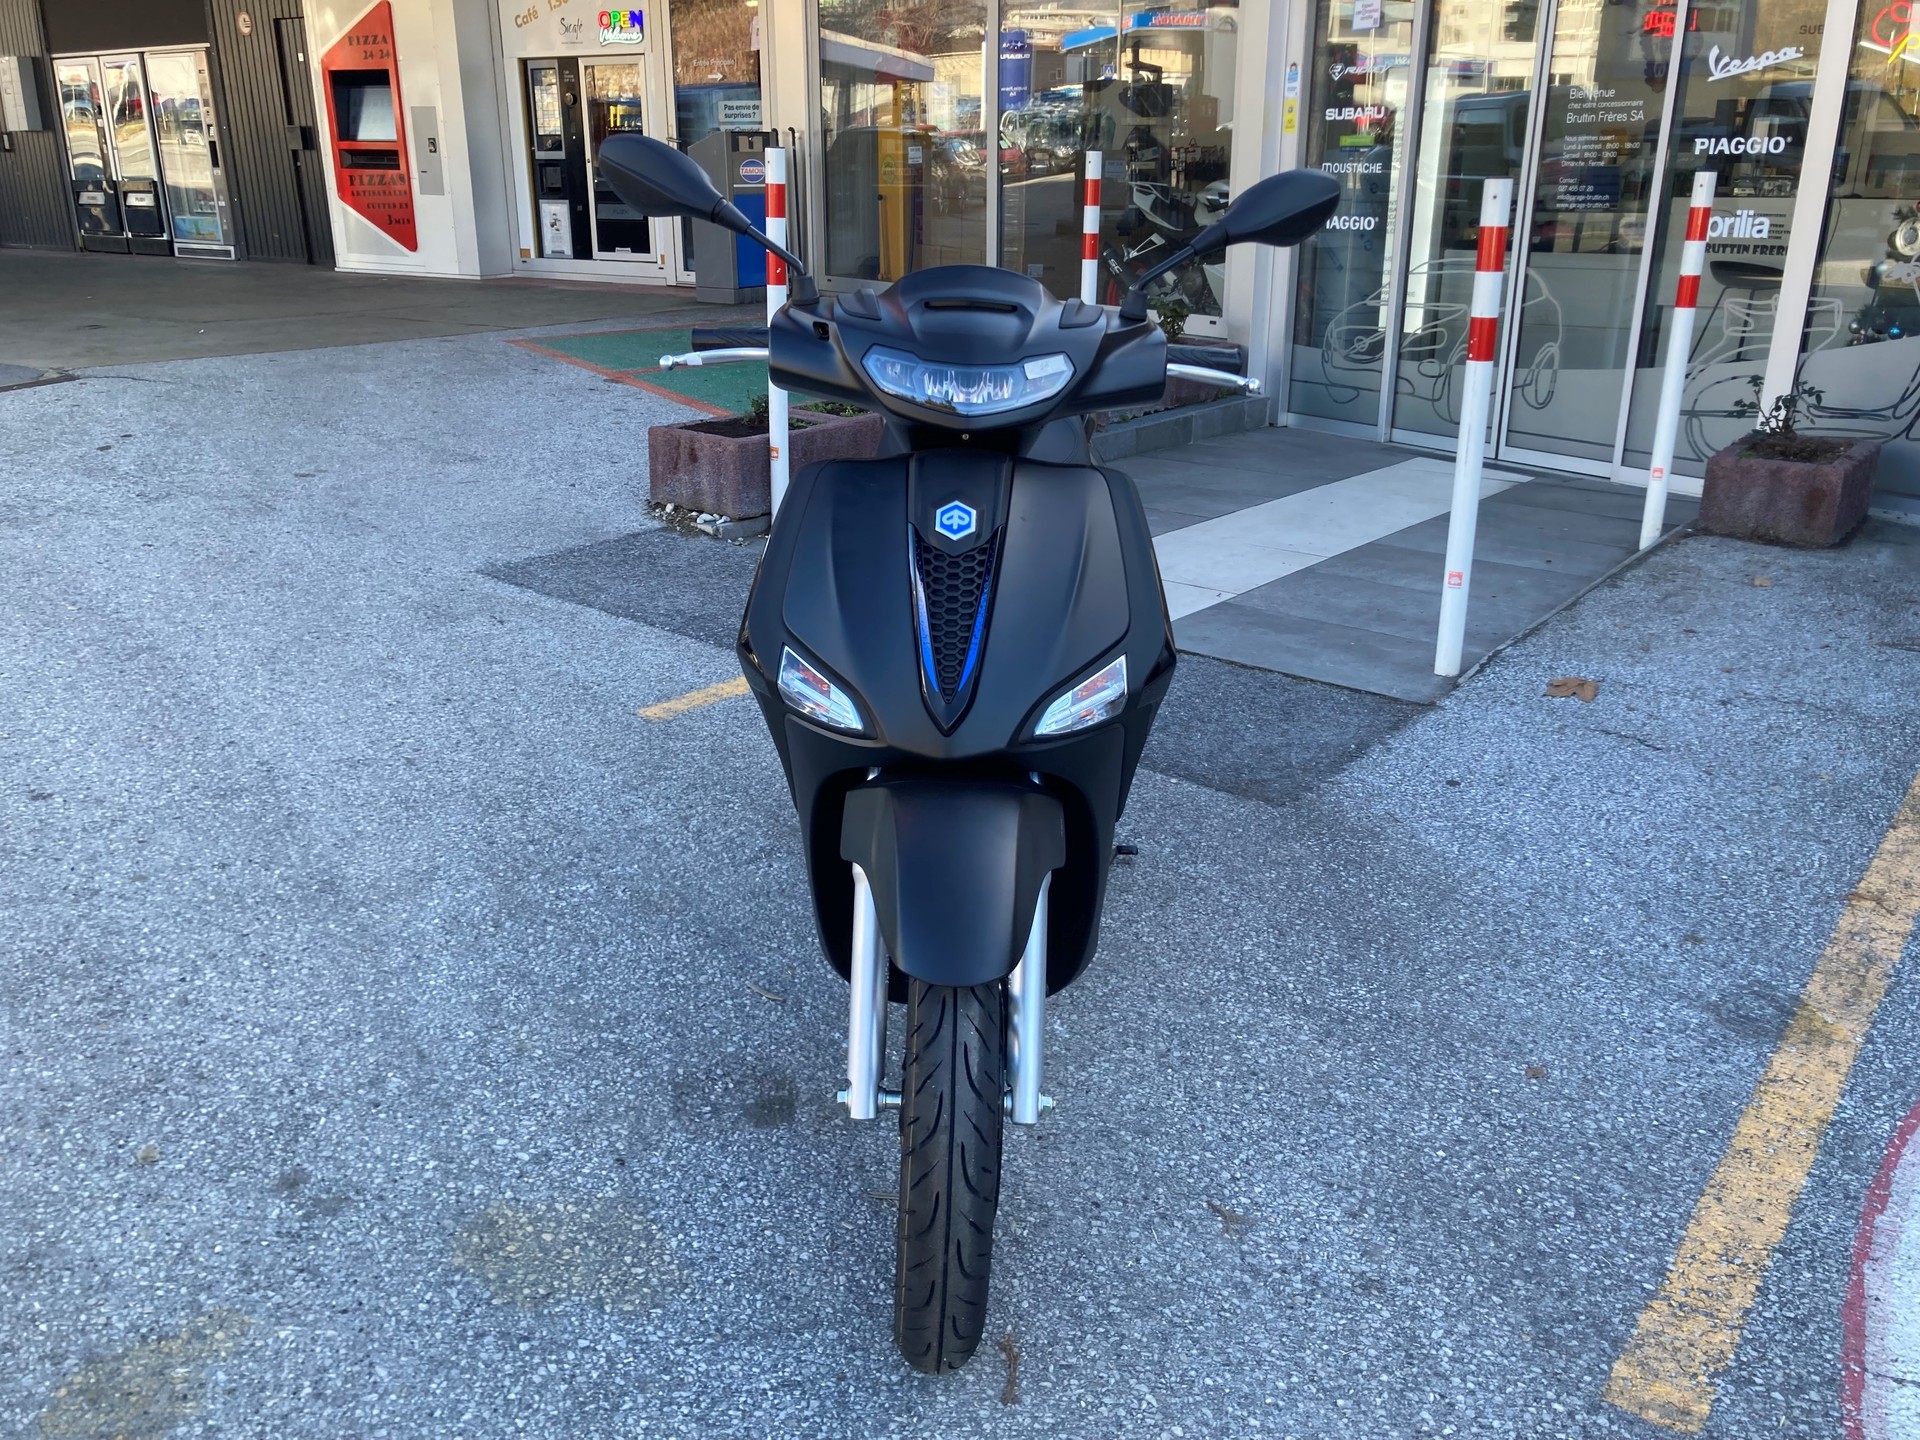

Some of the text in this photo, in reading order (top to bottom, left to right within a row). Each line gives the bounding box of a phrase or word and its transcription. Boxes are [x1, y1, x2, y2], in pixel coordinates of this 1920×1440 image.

[514, 5, 539, 28] Café
[597, 9, 643, 29] OPEN
[347, 34, 388, 46] PIZZA
[599, 26, 643, 47] Welcome
[1707, 44, 1804, 82] Vespa
[752, 103, 760, 111] de
[1597, 99, 1644, 108] concessionnaire
[724, 111, 751, 119] surprises
[1325, 106, 1385, 121] SUBARU
[1566, 110, 1645, 124] Bruttin Frères SA
[1694, 136, 1786, 155] PIAGGIO
[348, 173, 406, 186] PIZZAS
[1326, 215, 1375, 231] IAGGIO
[1709, 210, 1770, 239] prilia
[1705, 243, 1788, 257] RUTTIN FRER
